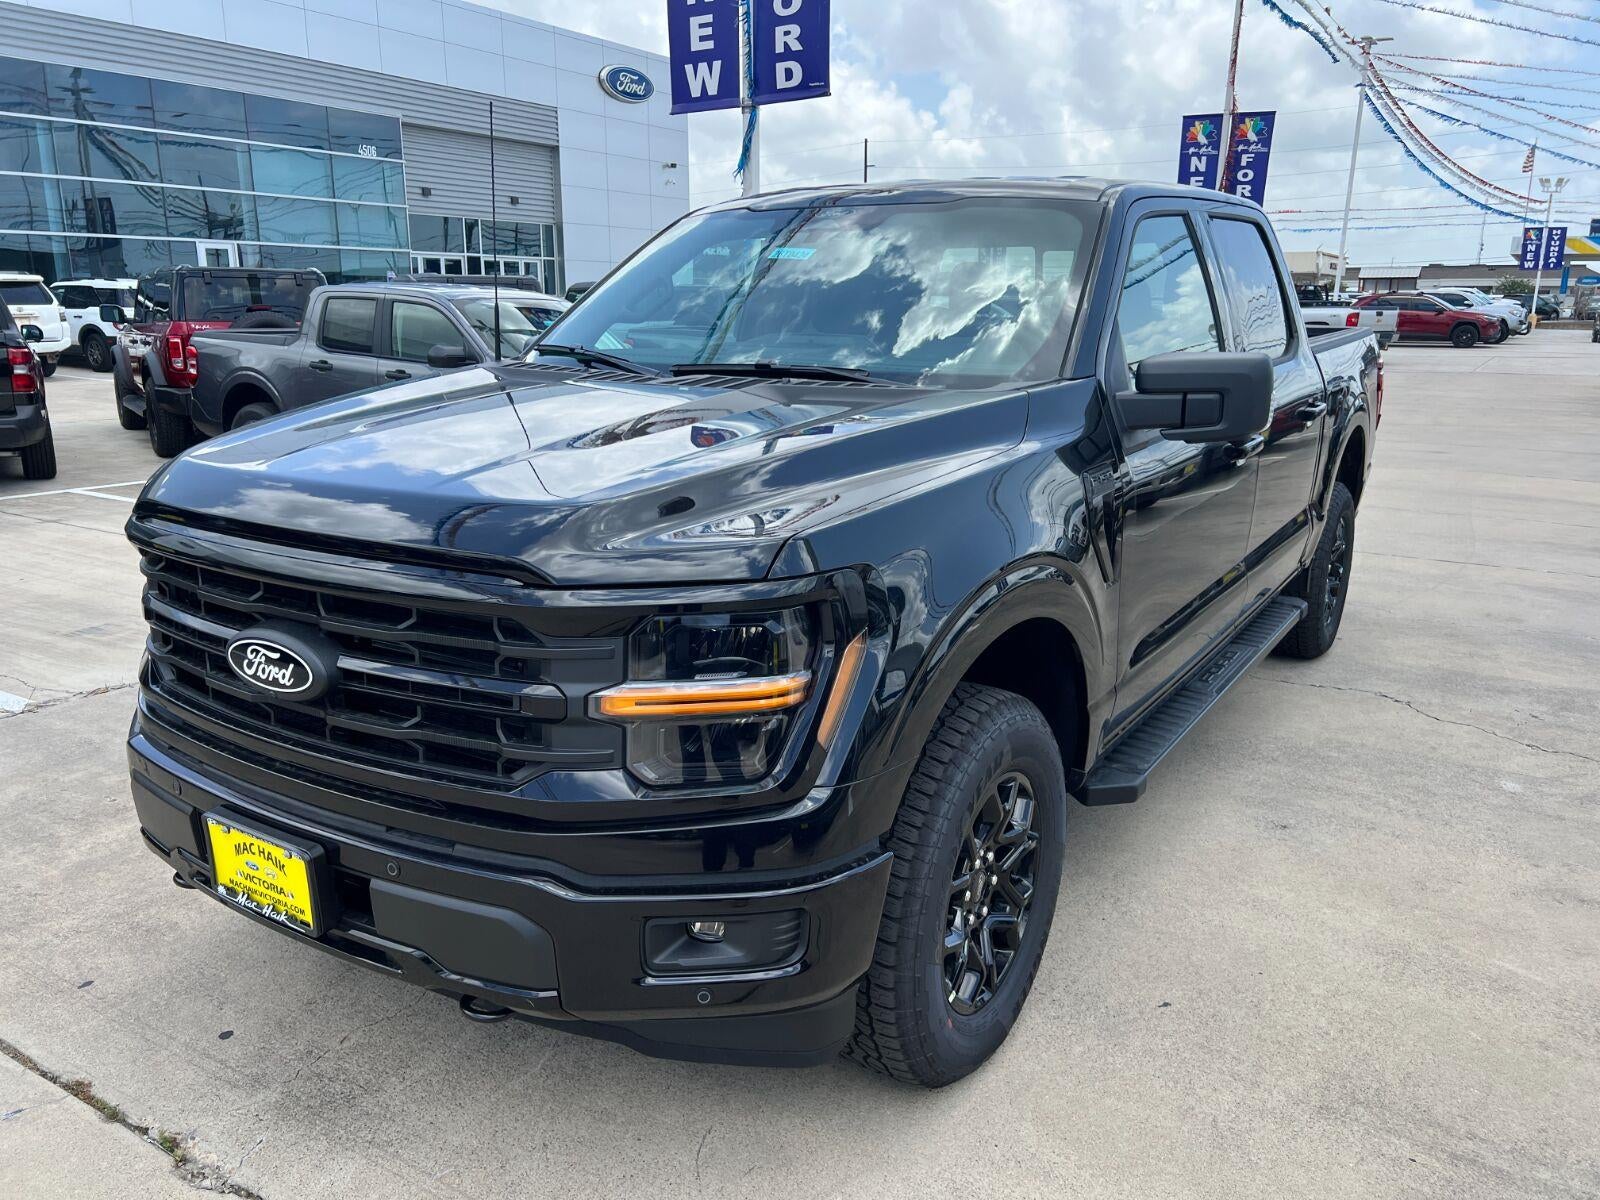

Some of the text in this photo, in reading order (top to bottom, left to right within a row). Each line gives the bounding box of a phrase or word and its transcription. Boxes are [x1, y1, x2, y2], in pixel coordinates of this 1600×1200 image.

[684, 0, 722, 98] EW
[617, 72, 645, 95] Ford
[358, 144, 377, 157] 4506
[1524, 244, 1536, 268] NEW
[1548, 229, 1561, 268] HYUNDAI
[243, 645, 295, 686] Ford
[234, 841, 288, 877] MAC HAIK
[242, 871, 287, 898] VICTORIA
[235, 892, 260, 911] Mac
